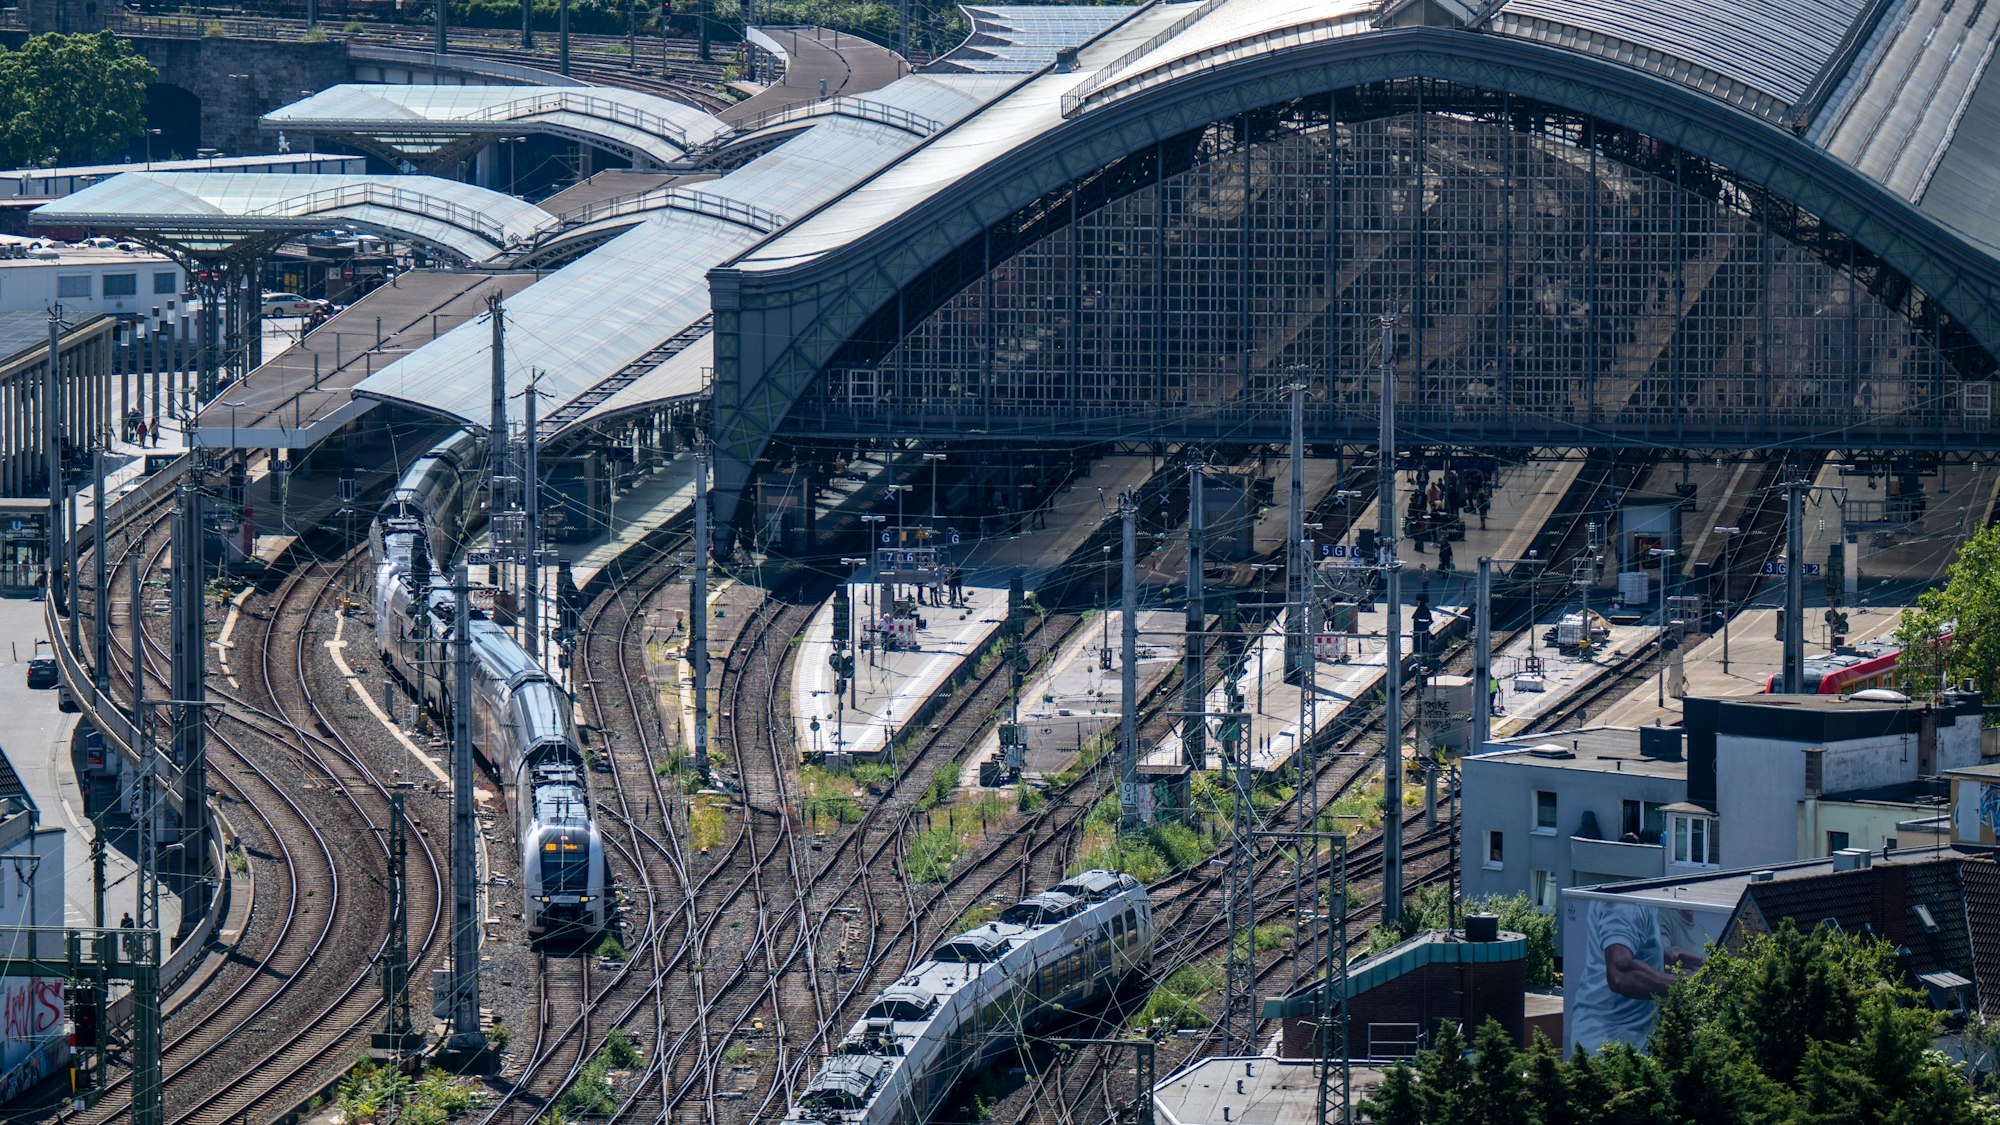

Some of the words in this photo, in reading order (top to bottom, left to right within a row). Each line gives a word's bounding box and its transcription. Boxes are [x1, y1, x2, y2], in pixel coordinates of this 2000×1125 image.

[271, 460, 280, 469] 10
[12, 520, 21, 531] U
[881, 533, 890, 543] G
[951, 534, 960, 544] G
[1323, 546, 1330, 556] 5
[1335, 547, 1343, 557] G
[468, 554, 477, 564] G
[887, 553, 893, 562] 7
[906, 552, 913, 562] 6
[1766, 563, 1772, 572] 3
[1811, 565, 1818, 574] 2
